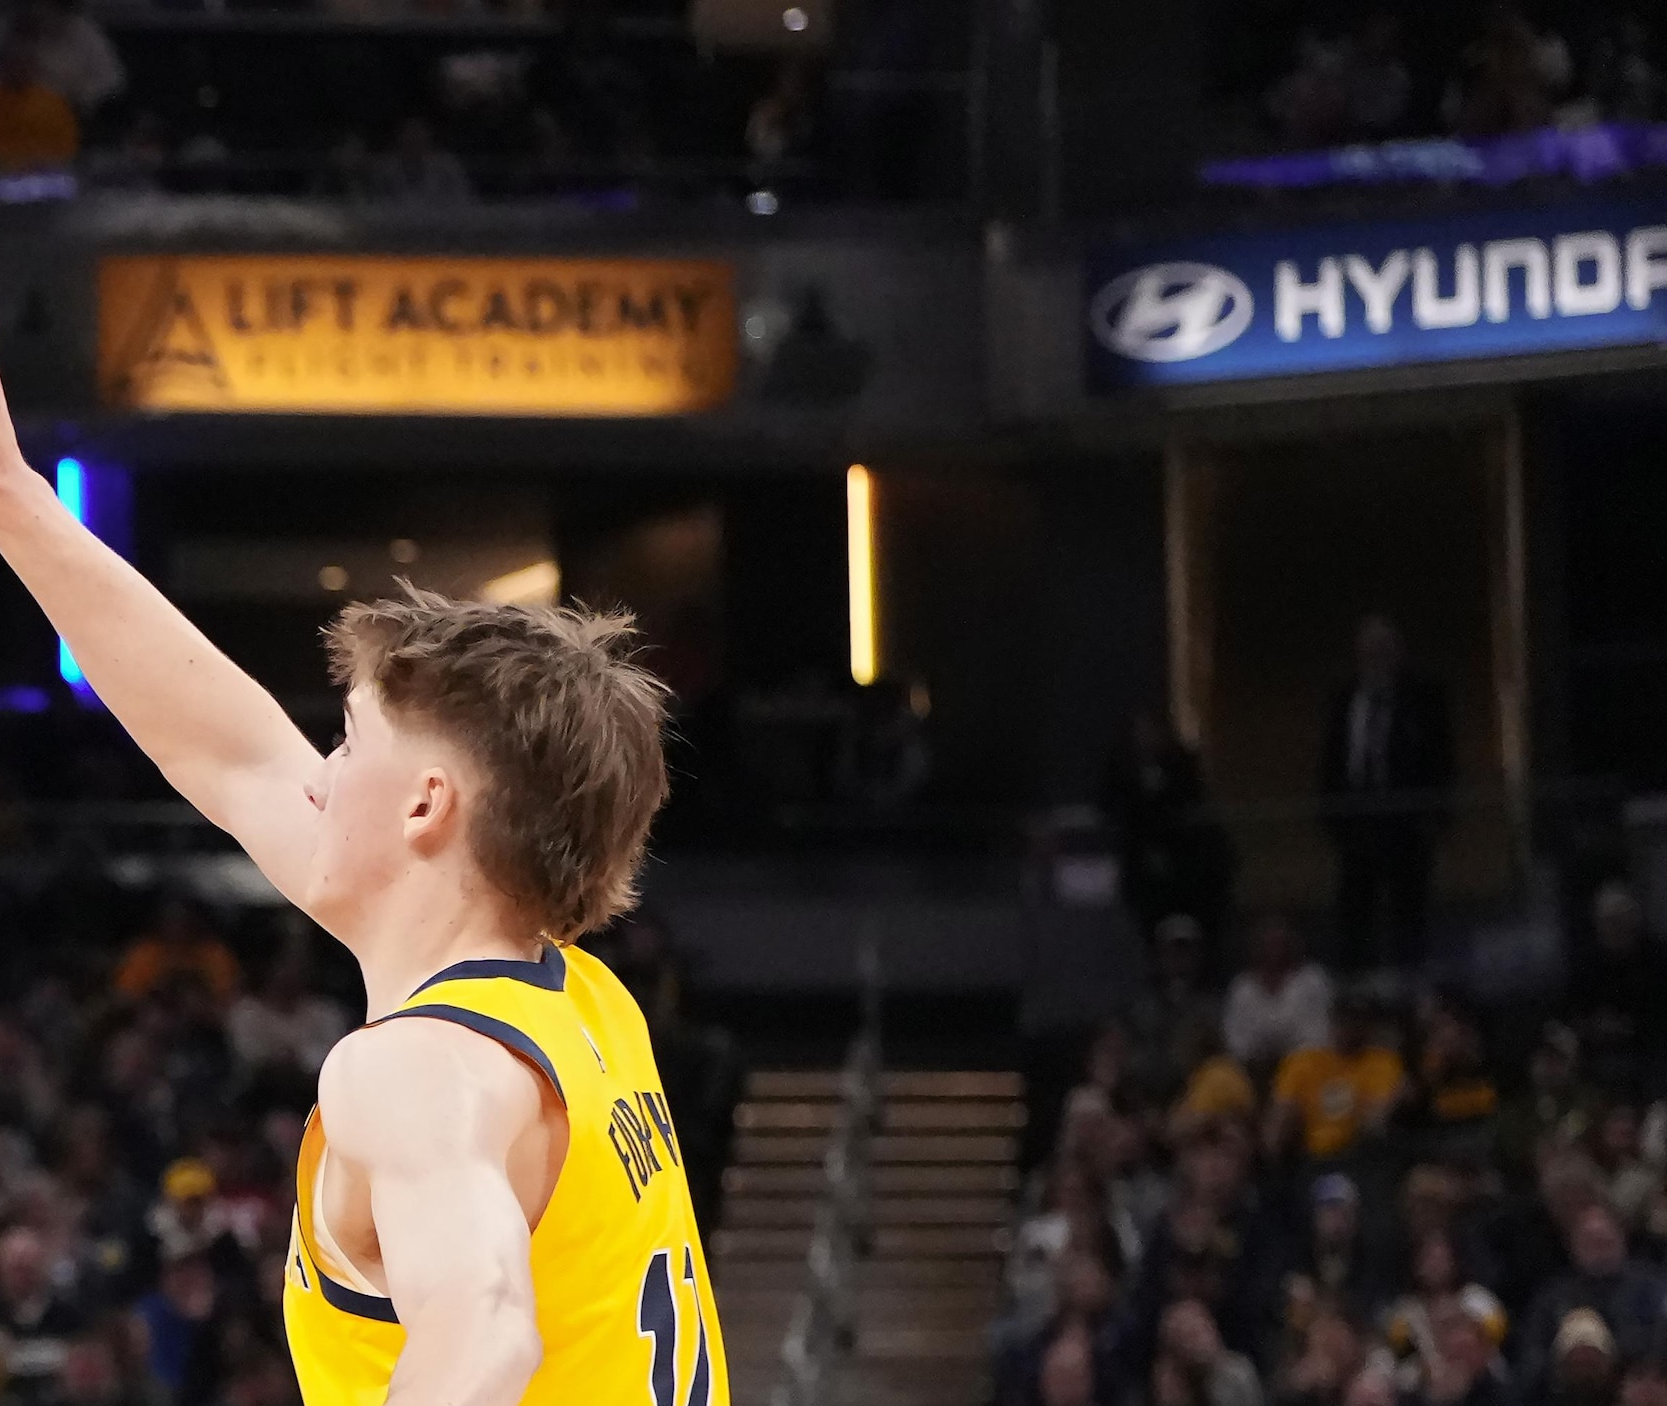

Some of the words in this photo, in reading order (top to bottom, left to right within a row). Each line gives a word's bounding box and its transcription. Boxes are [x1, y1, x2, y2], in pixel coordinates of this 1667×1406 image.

[222, 278, 359, 332] LIFT
[383, 278, 711, 334] ACADEMY
[1273, 223, 1667, 343] HYUNDA
